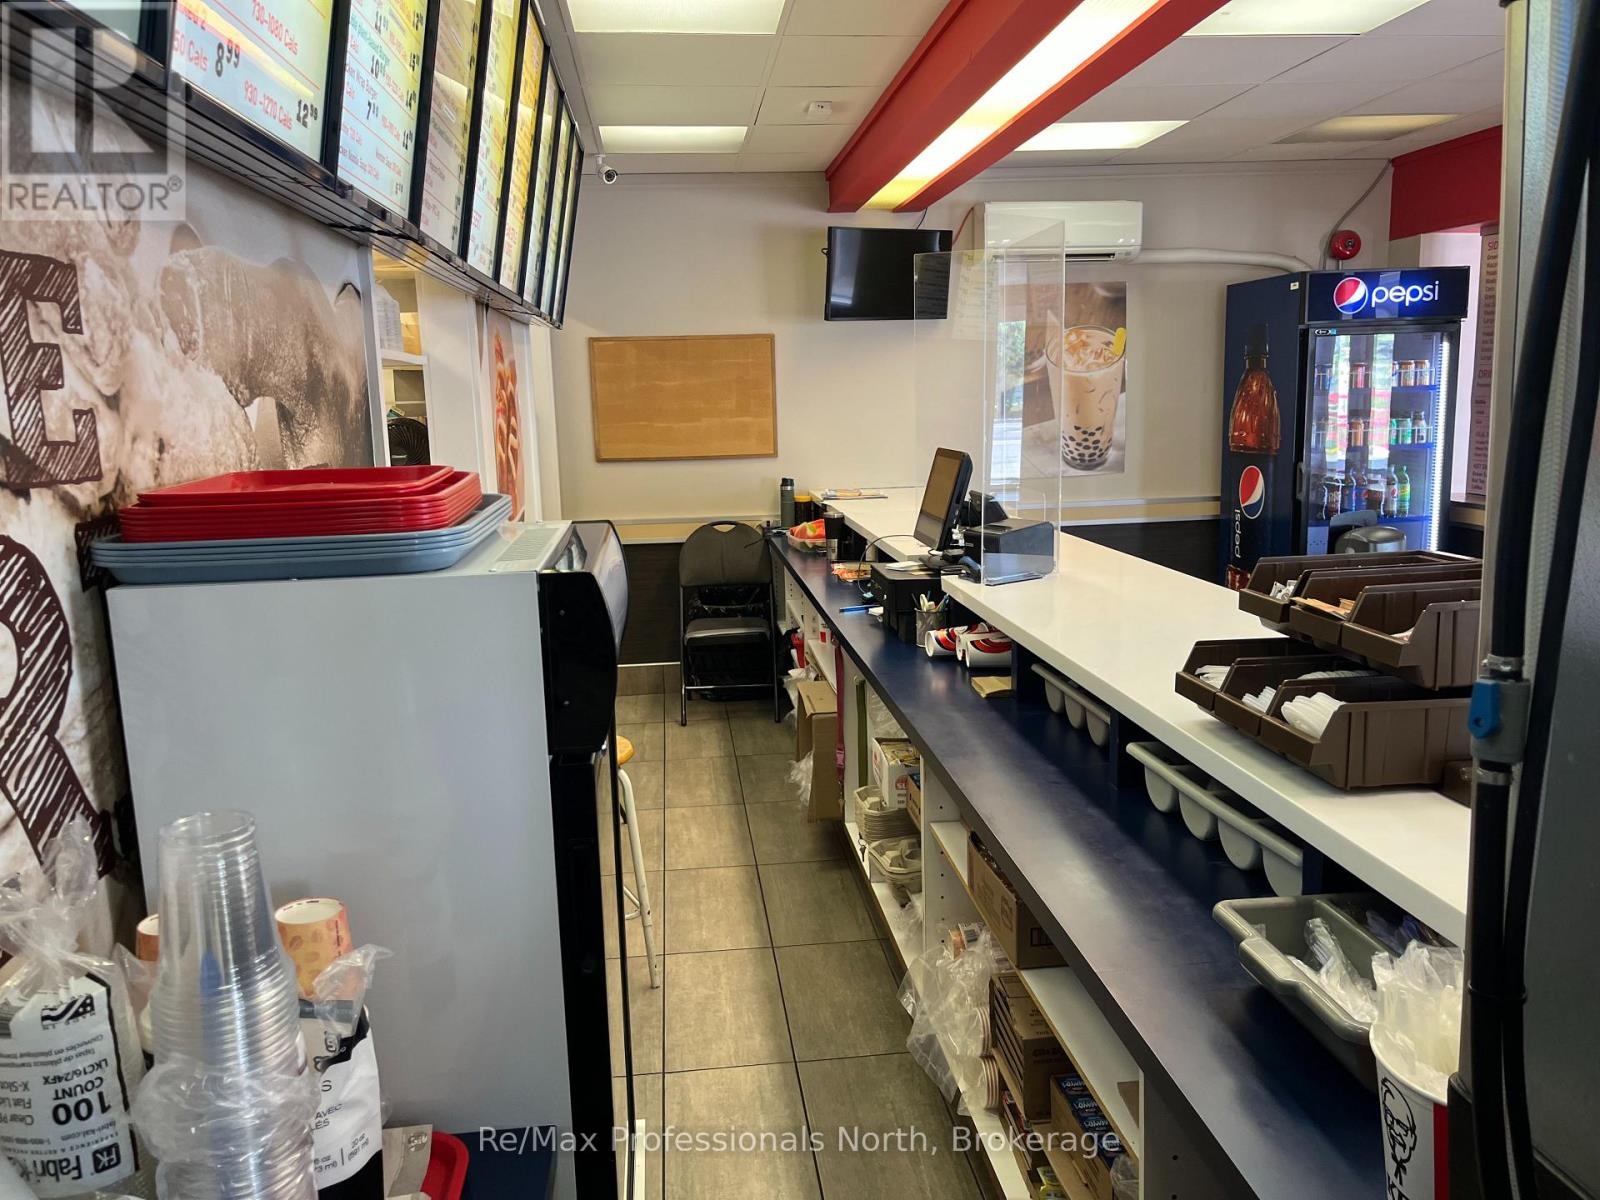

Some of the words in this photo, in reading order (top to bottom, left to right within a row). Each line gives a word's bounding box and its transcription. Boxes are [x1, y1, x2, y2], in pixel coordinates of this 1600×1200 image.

[188, 40, 208, 71] Cals
[1371, 280, 1440, 308] pepsi
[1234, 509, 1242, 559] pepsi
[43, 1058, 109, 1086] LKC16/24FX
[53, 1076, 104, 1101] COUNT
[52, 1091, 112, 1126] 100
[315, 1103, 343, 1120] AVEC
